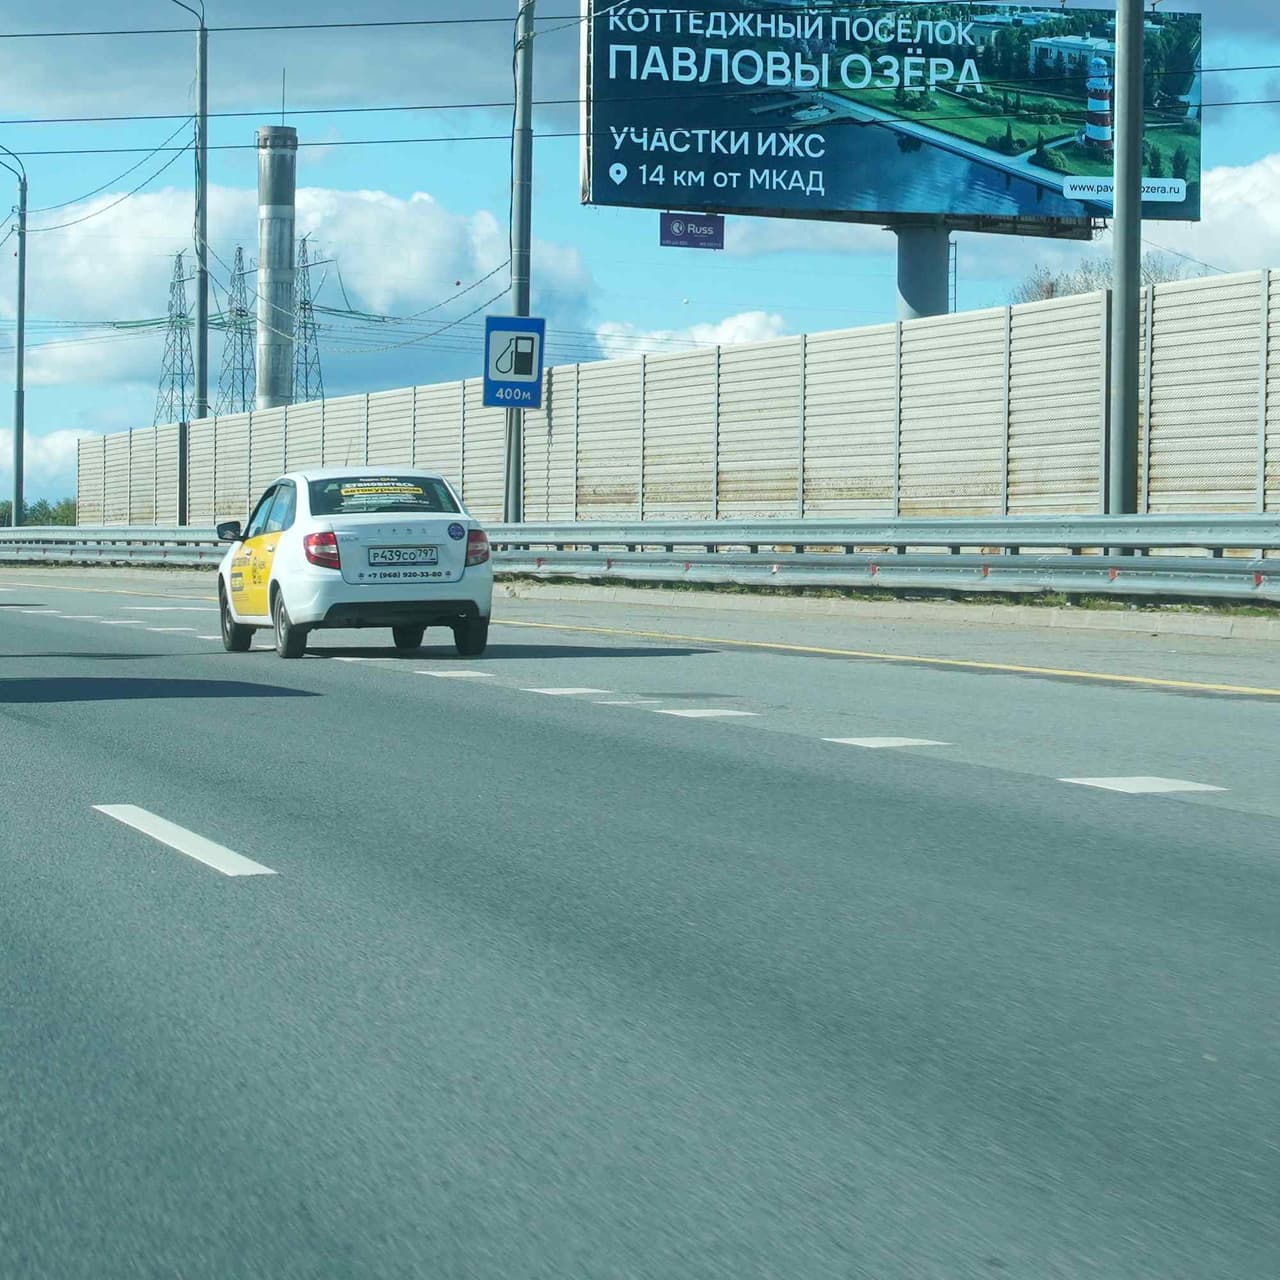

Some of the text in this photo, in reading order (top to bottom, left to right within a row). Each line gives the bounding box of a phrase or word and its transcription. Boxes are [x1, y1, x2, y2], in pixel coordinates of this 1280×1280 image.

[609, 7, 975, 46] КОТТЕДЖНЫЙ ПОСЁЛОК
[609, 44, 983, 94] ПАВЛОВЫ ОЗЁРА
[609, 126, 826, 158] УЧАСТКИ ИЖС
[638, 164, 825, 196] 14 км от МКАД
[687, 223, 715, 235] Russ
